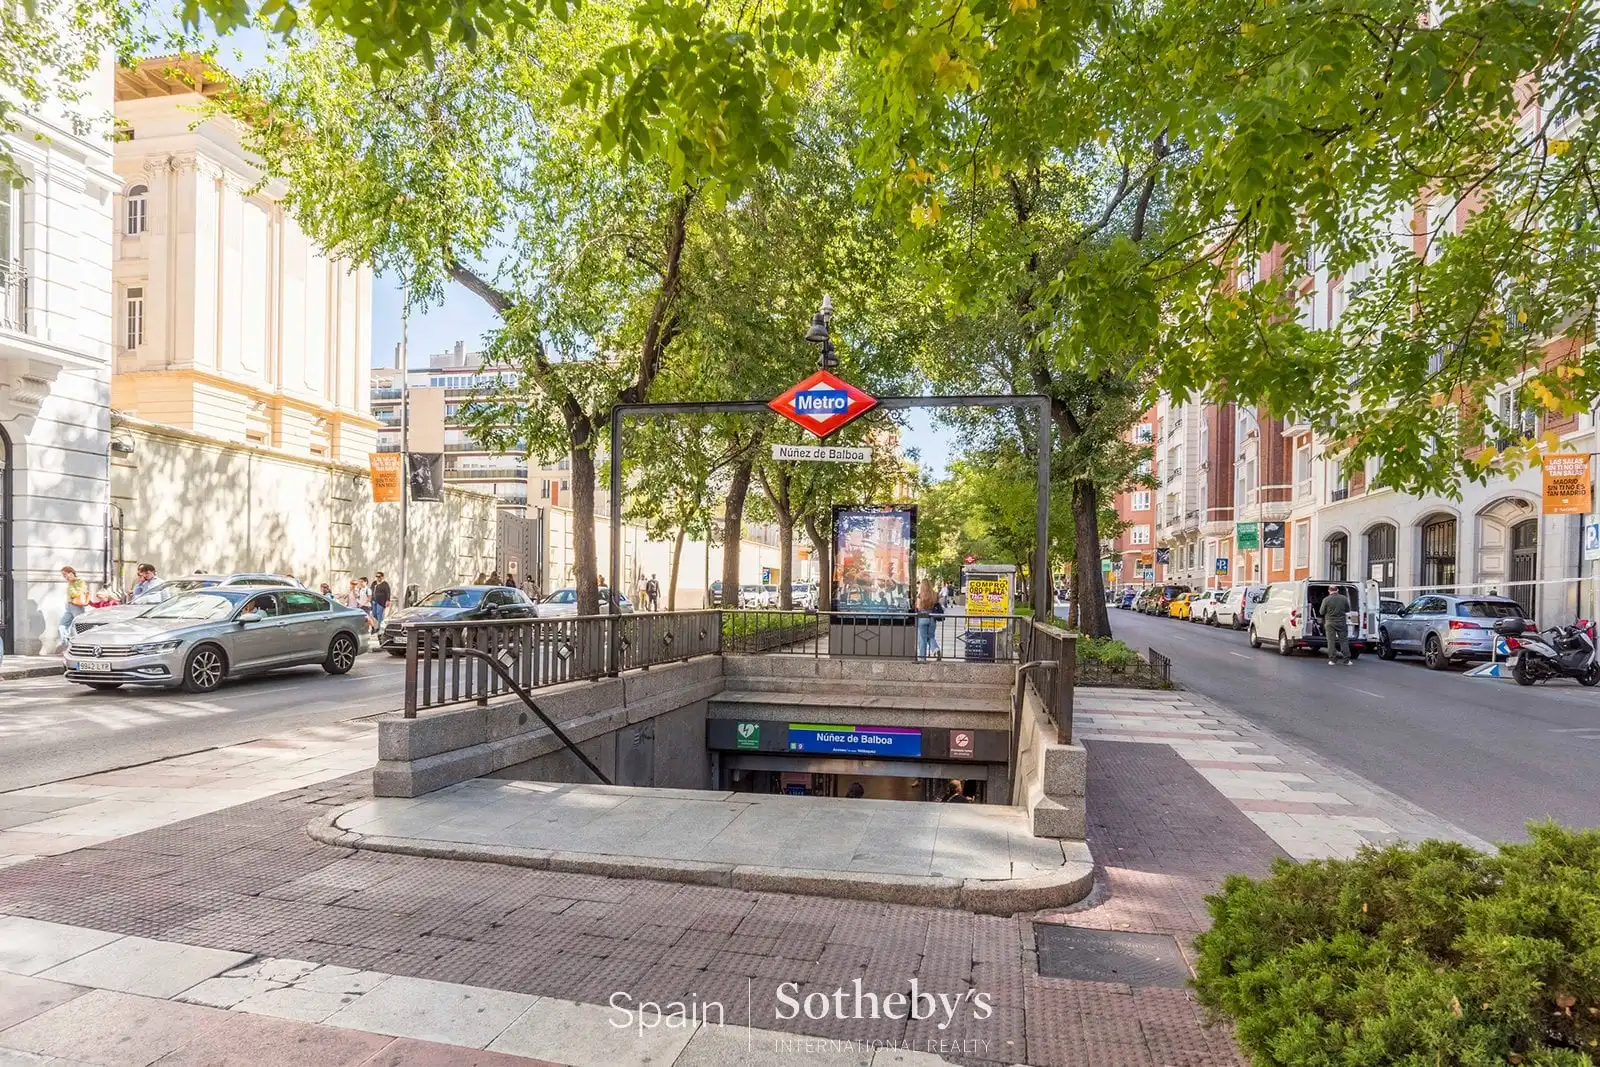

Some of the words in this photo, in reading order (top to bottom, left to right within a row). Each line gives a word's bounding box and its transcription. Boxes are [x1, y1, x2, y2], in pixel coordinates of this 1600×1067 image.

[798, 395, 845, 409] Metro
[779, 447, 811, 458] Núñez
[813, 449, 826, 459] de
[829, 449, 864, 460] Balboa
[816, 732, 845, 743] Núñez
[847, 734, 859, 744] de
[861, 735, 893, 745] Balboa
